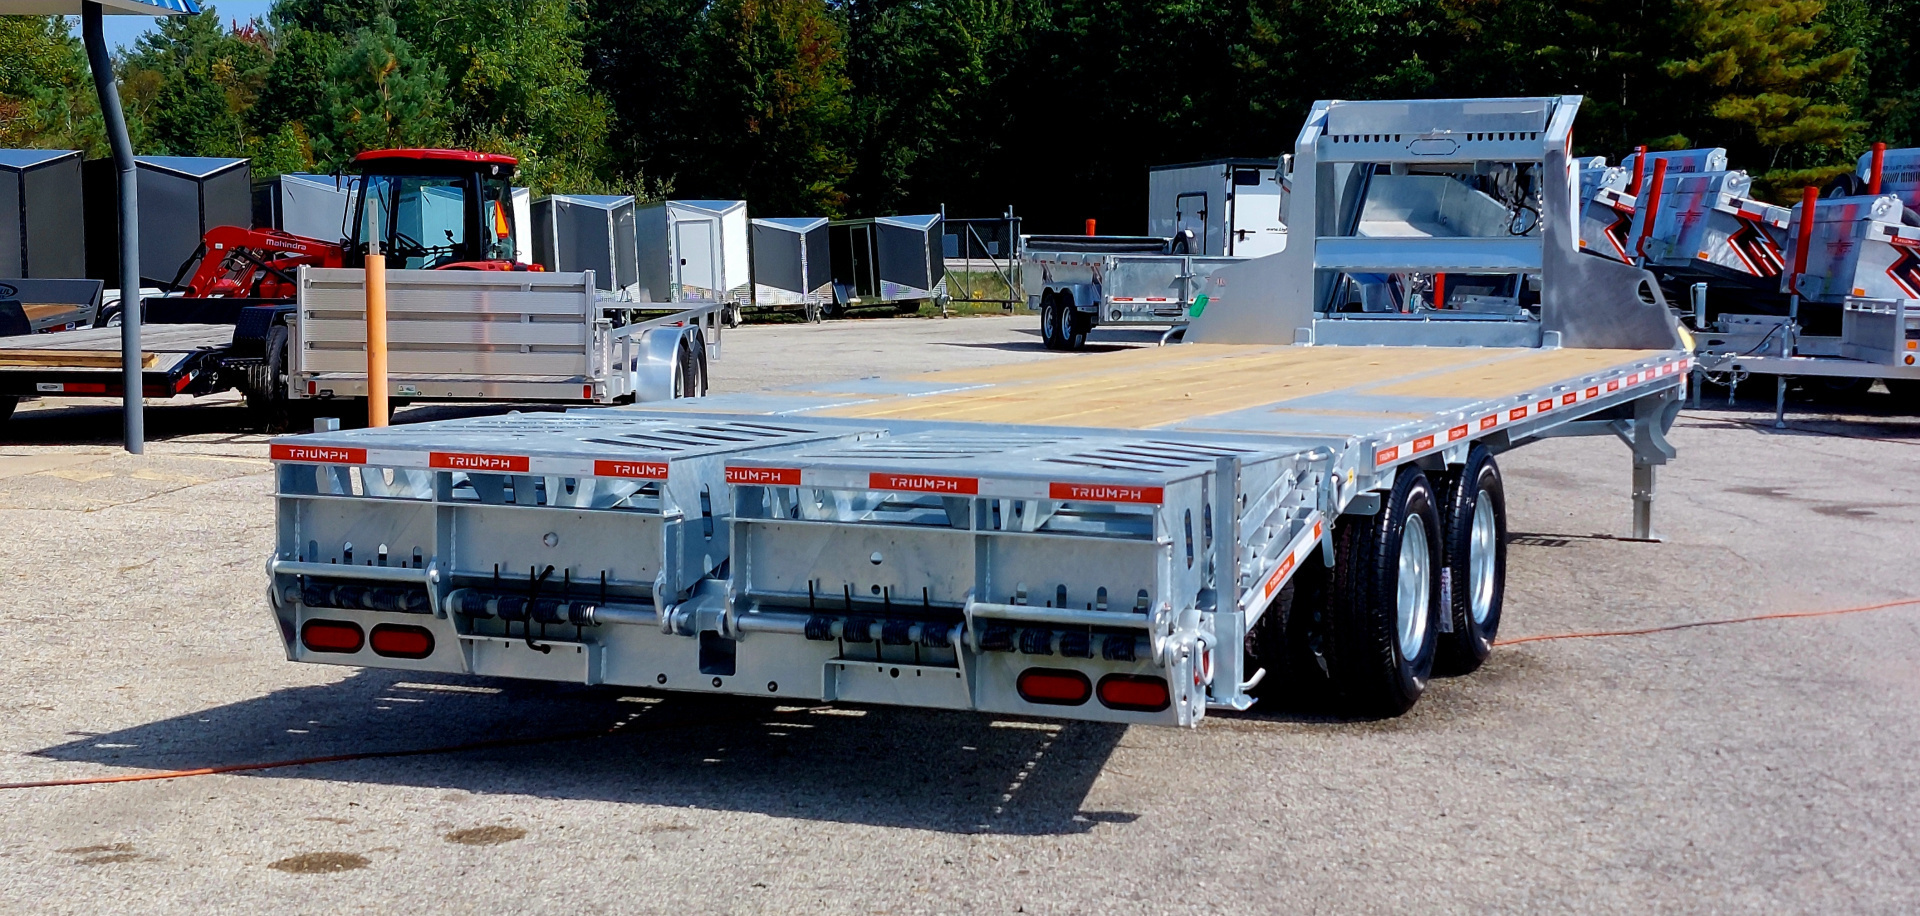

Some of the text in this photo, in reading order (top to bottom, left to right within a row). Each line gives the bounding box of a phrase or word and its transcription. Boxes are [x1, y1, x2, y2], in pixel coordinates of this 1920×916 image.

[266, 239, 307, 251] Mahindra
[289, 449, 349, 460] TRIUMPH
[448, 456, 510, 469] TRIUMPH
[614, 464, 667, 476] TRIUMP
[890, 477, 958, 491] TRIUMPH
[1071, 482, 1141, 500] TRIUMPH
